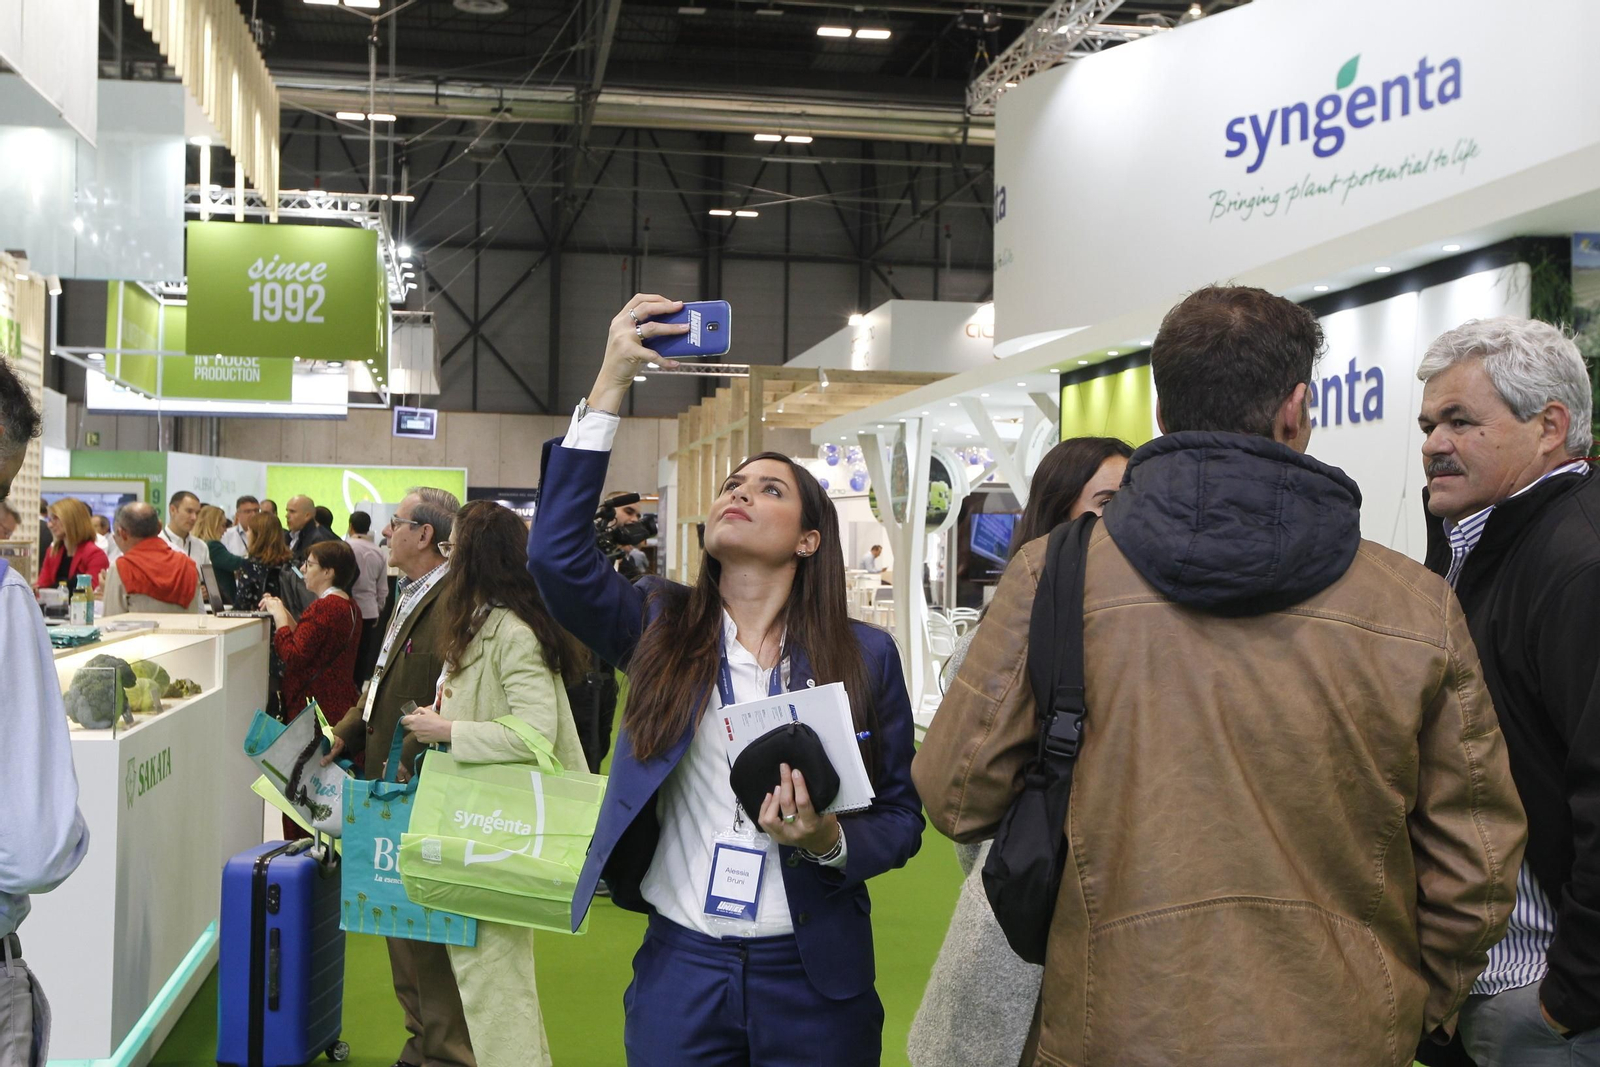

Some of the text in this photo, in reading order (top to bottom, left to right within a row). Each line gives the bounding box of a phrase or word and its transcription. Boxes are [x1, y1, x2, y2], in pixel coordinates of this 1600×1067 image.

[1225, 55, 1461, 174] syngenta
[1209, 138, 1481, 222] Bringing plant potential to life
[248, 254, 327, 282] since
[248, 282, 326, 323] 1992
[194, 366, 260, 382] PRODUCTION
[138, 746, 171, 796] SAKATA
[454, 809, 532, 835] syngenta
[725, 866, 750, 877] Alessia
[726, 876, 745, 885] Bruni
